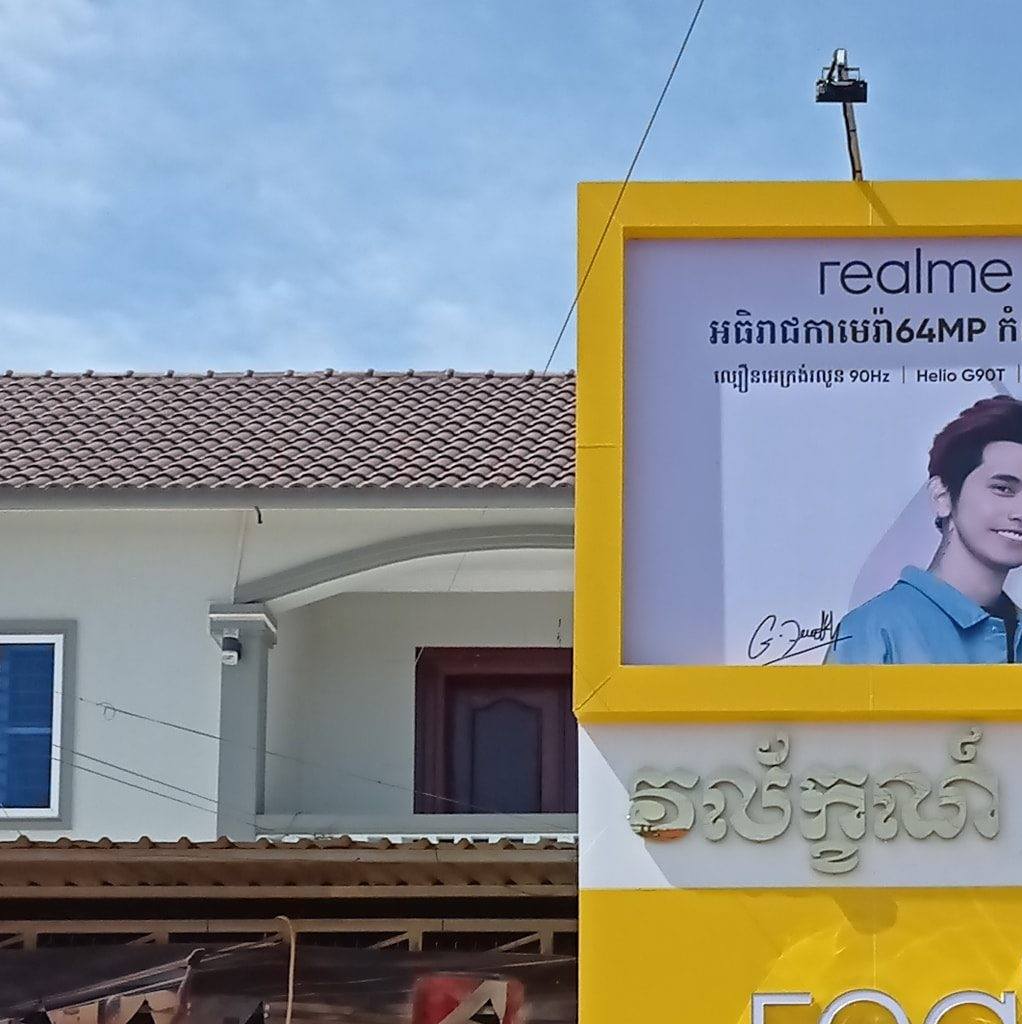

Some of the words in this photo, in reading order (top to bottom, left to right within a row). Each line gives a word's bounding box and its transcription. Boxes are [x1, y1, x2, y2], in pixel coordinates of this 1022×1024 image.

[819, 248, 1013, 295] realme
[850, 368, 890, 384] 90Hz
[916, 368, 957, 383] Helio
[961, 368, 1006, 383] G90T
